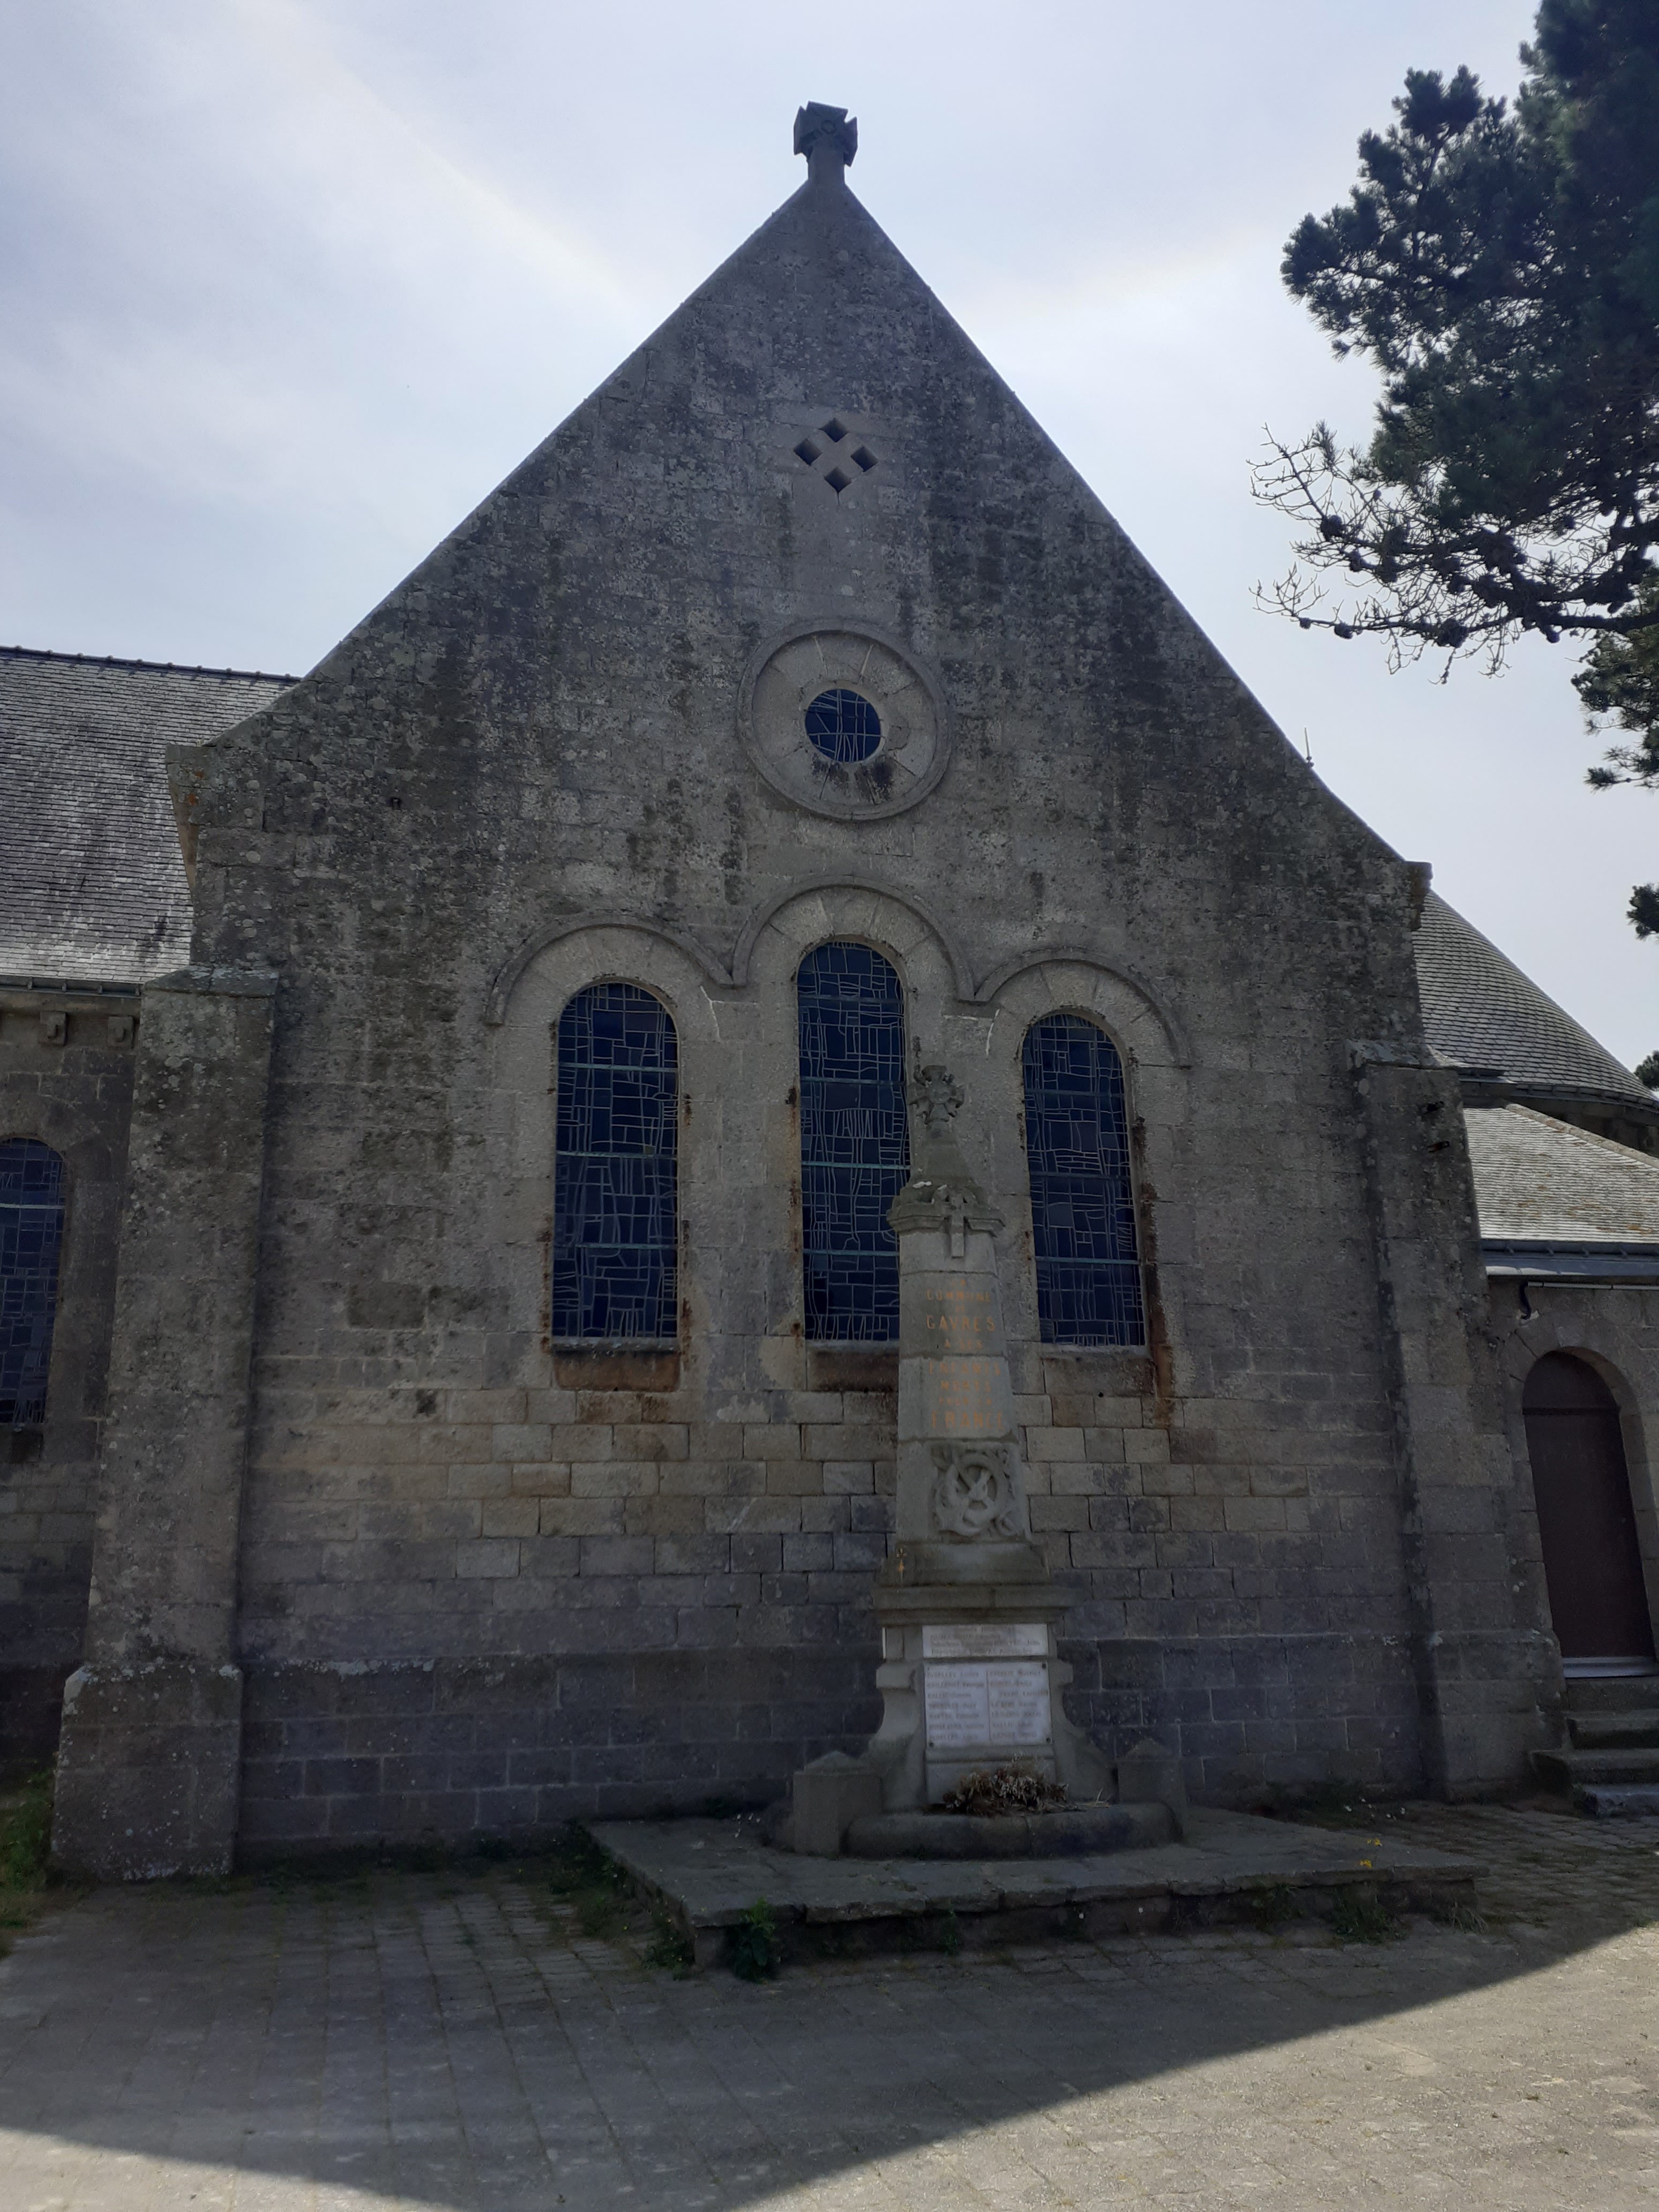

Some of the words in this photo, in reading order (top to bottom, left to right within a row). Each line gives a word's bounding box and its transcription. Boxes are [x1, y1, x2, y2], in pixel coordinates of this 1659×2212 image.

[926, 1288, 990, 1303] COMMUNE
[926, 1314, 995, 1332] GAVRES
[929, 1361, 1002, 1377] ENFANTS
[931, 1410, 1004, 1430] FRANCE
